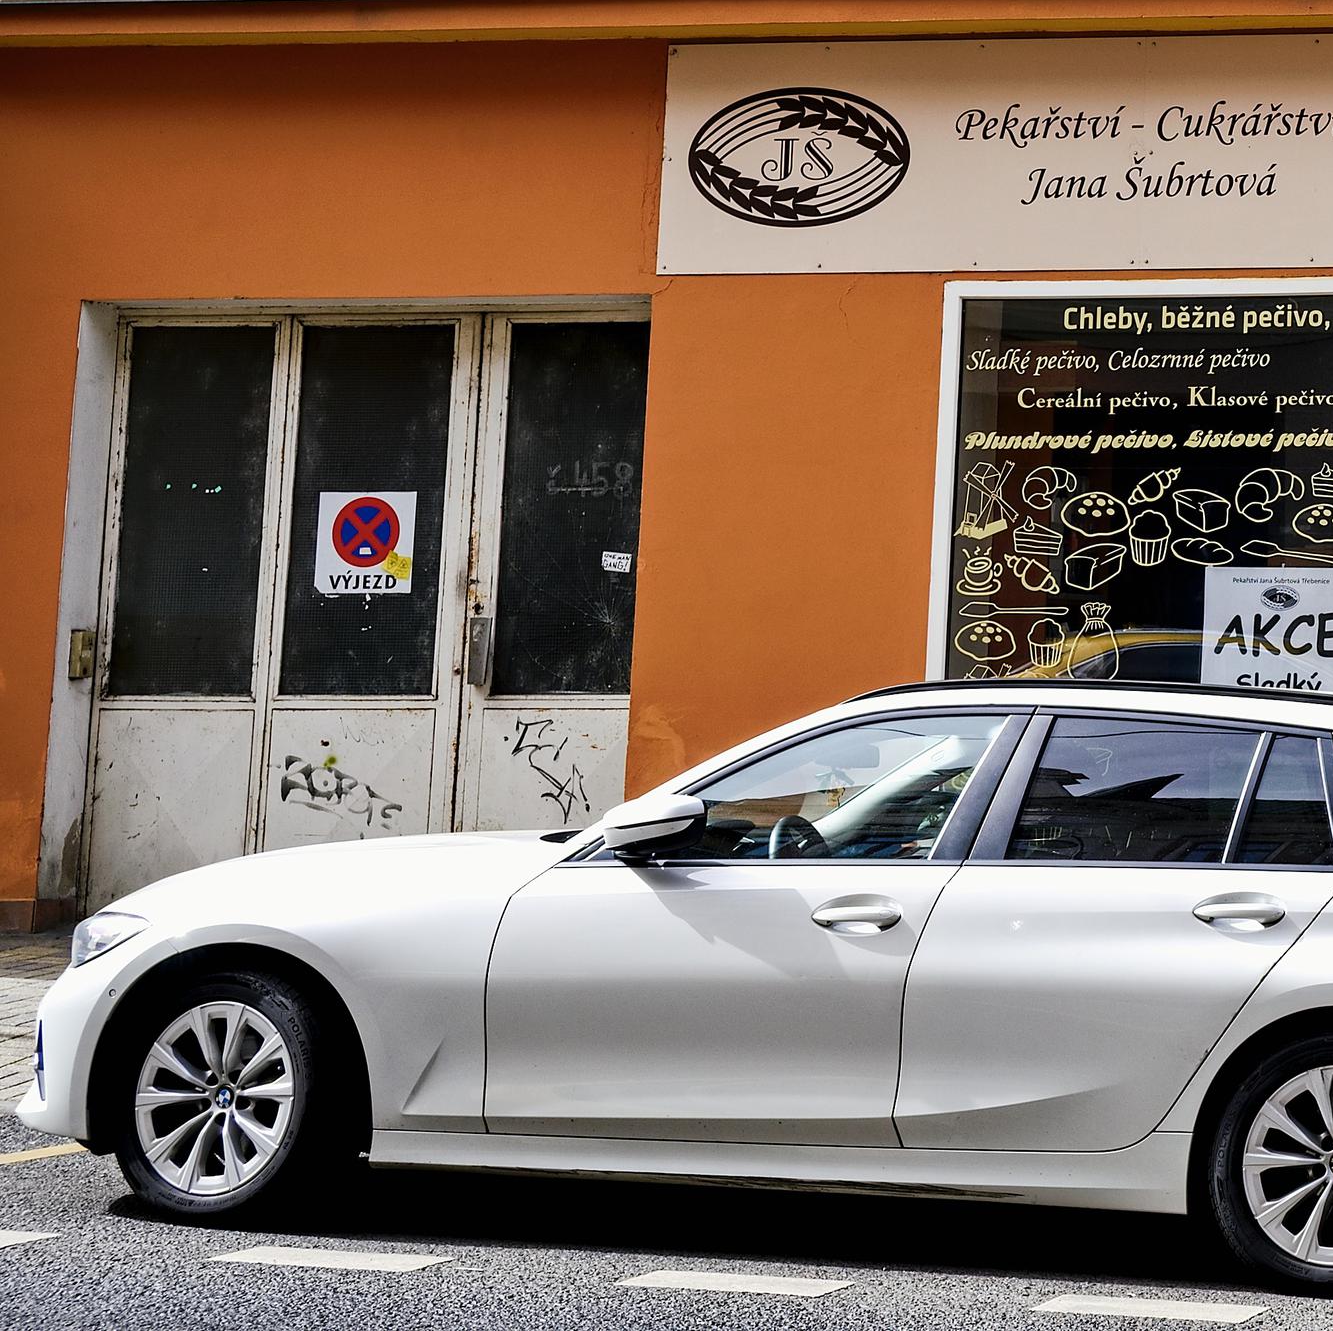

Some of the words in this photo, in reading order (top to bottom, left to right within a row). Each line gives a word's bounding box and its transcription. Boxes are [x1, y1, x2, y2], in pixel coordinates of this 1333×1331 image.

[955, 103, 1127, 148] Pekařství
[760, 129, 834, 183] JŠ
[1020, 167, 1107, 206] Jana
[1115, 155, 1277, 201] Šubrtová
[1063, 305, 1153, 335] Chleby,
[1161, 304, 1235, 330] běžné
[1243, 304, 1331, 334] pečivo,
[966, 348, 1031, 375] Sladké
[1033, 349, 1100, 376] pečivo,
[1108, 347, 1204, 372] Celozrnné
[1207, 347, 1271, 375] pečivo
[1017, 387, 1102, 410] Cereální
[1108, 390, 1179, 415] pečivo,
[1186, 385, 1269, 408] Klasové
[964, 430, 1093, 453] Plundrové
[1092, 429, 1177, 454] pečivo,
[1182, 428, 1274, 452] Listové
[328, 569, 397, 590] VÝJEZD
